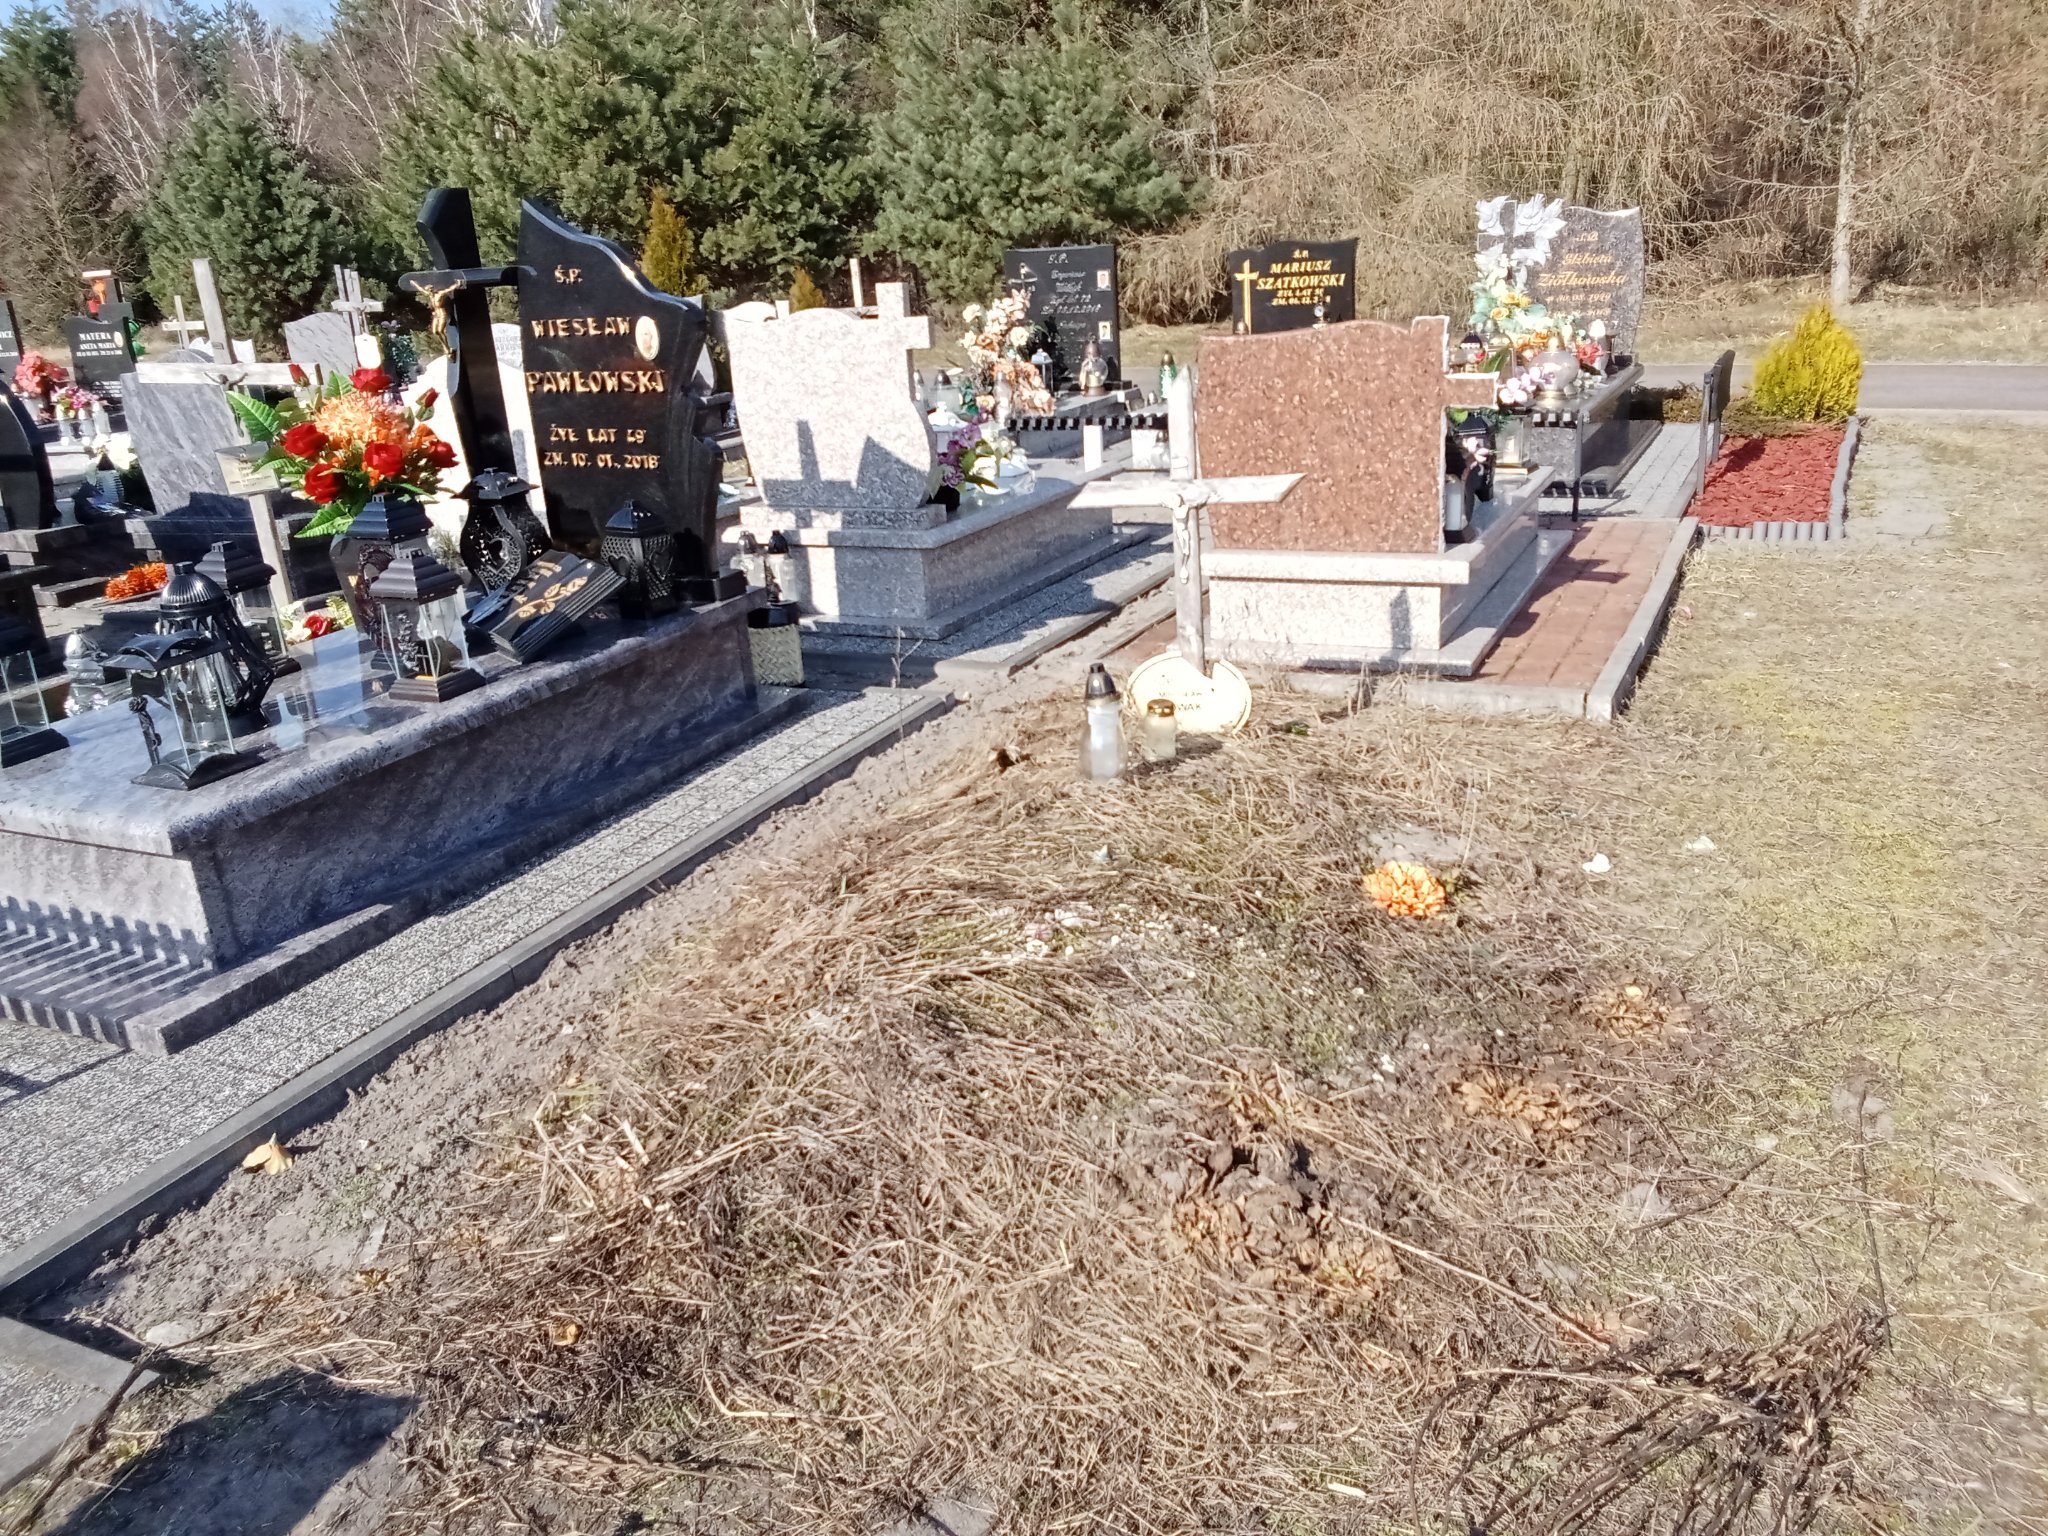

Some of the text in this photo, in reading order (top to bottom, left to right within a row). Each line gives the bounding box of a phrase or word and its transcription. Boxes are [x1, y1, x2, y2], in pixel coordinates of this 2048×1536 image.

[1562, 252, 1612, 265] Elżbieta
[554, 264, 583, 284] Ś.P.
[1270, 260, 1332, 273] MARIUSZ
[1256, 273, 1346, 290] SZATKOWSKI
[531, 316, 631, 338] WIESŁAW
[78, 332, 112, 341] MATERA
[527, 370, 667, 394] PAWŁOWSKI
[587, 428, 618, 443] LAT
[622, 454, 661, 469] 2018
